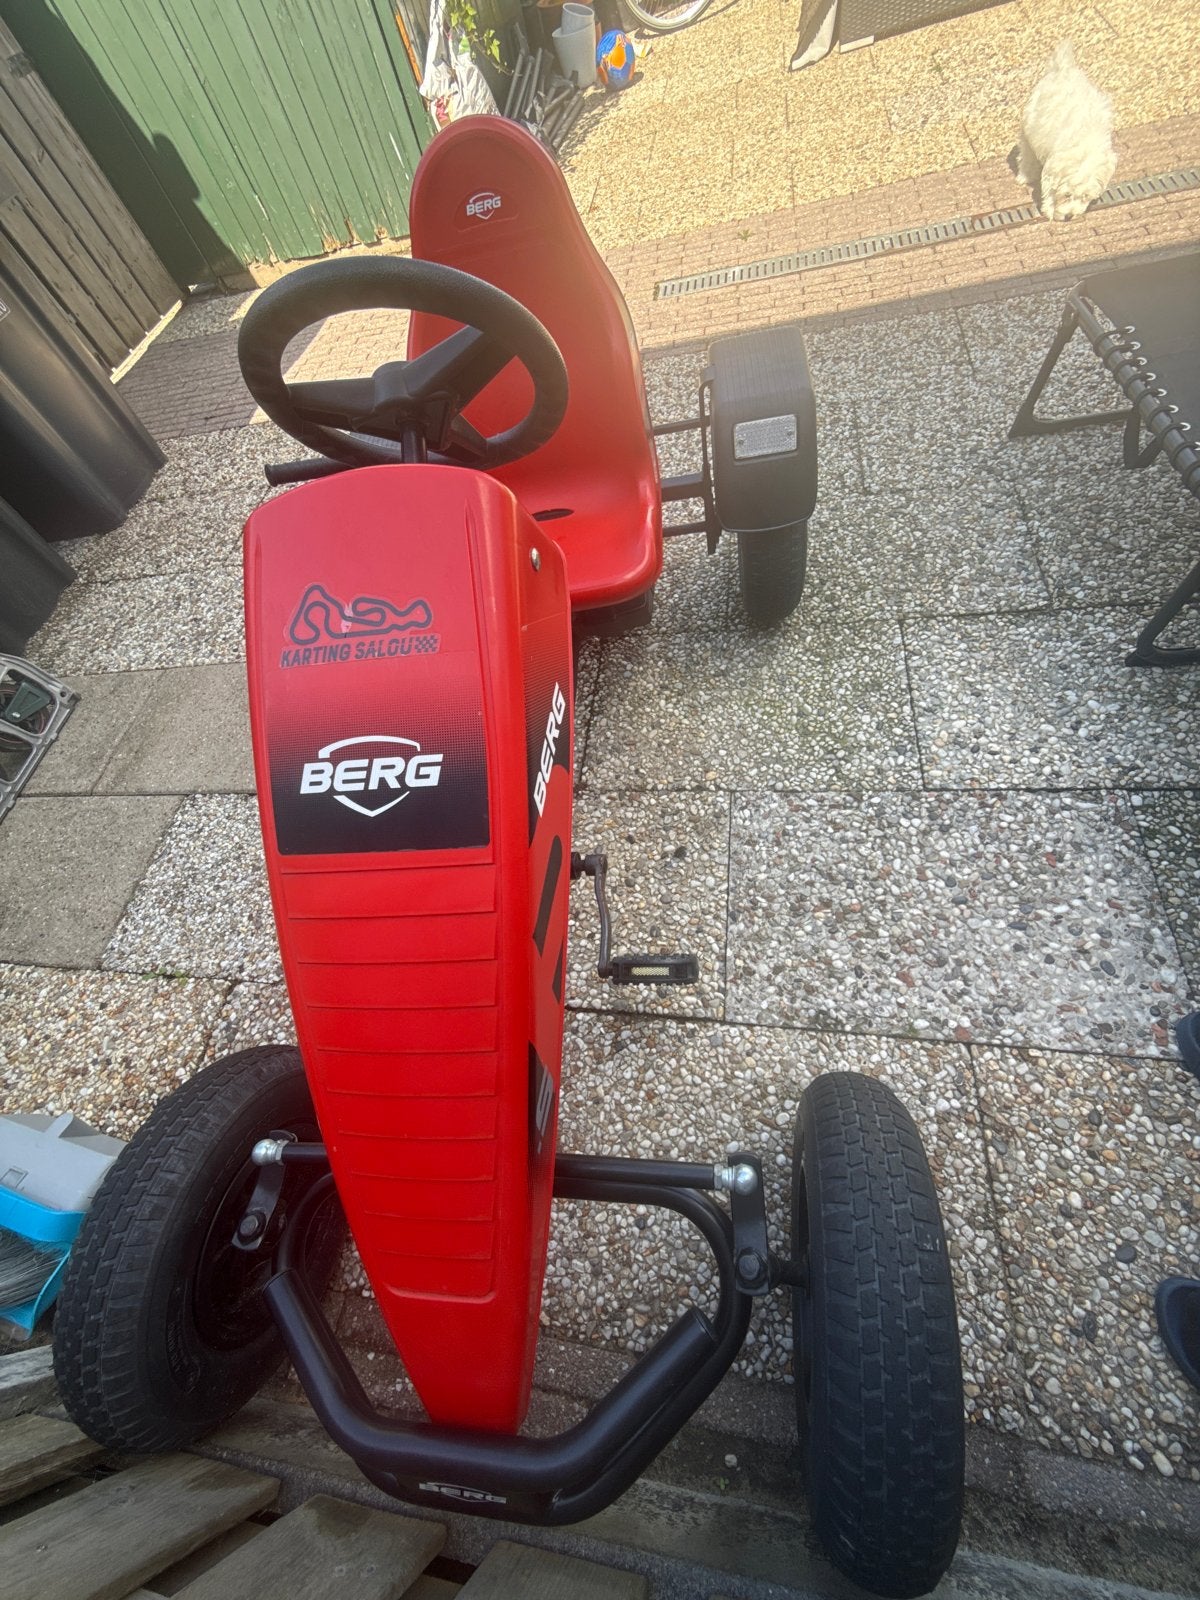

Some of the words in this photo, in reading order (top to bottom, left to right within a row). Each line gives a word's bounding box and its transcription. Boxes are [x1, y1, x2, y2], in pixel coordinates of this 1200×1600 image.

[466, 196, 502, 216] BERG
[280, 643, 351, 667] KARTING
[355, 637, 412, 660] SALOU
[533, 682, 566, 818] BERG
[300, 753, 443, 795] BERG
[419, 1483, 507, 1504] BERG
